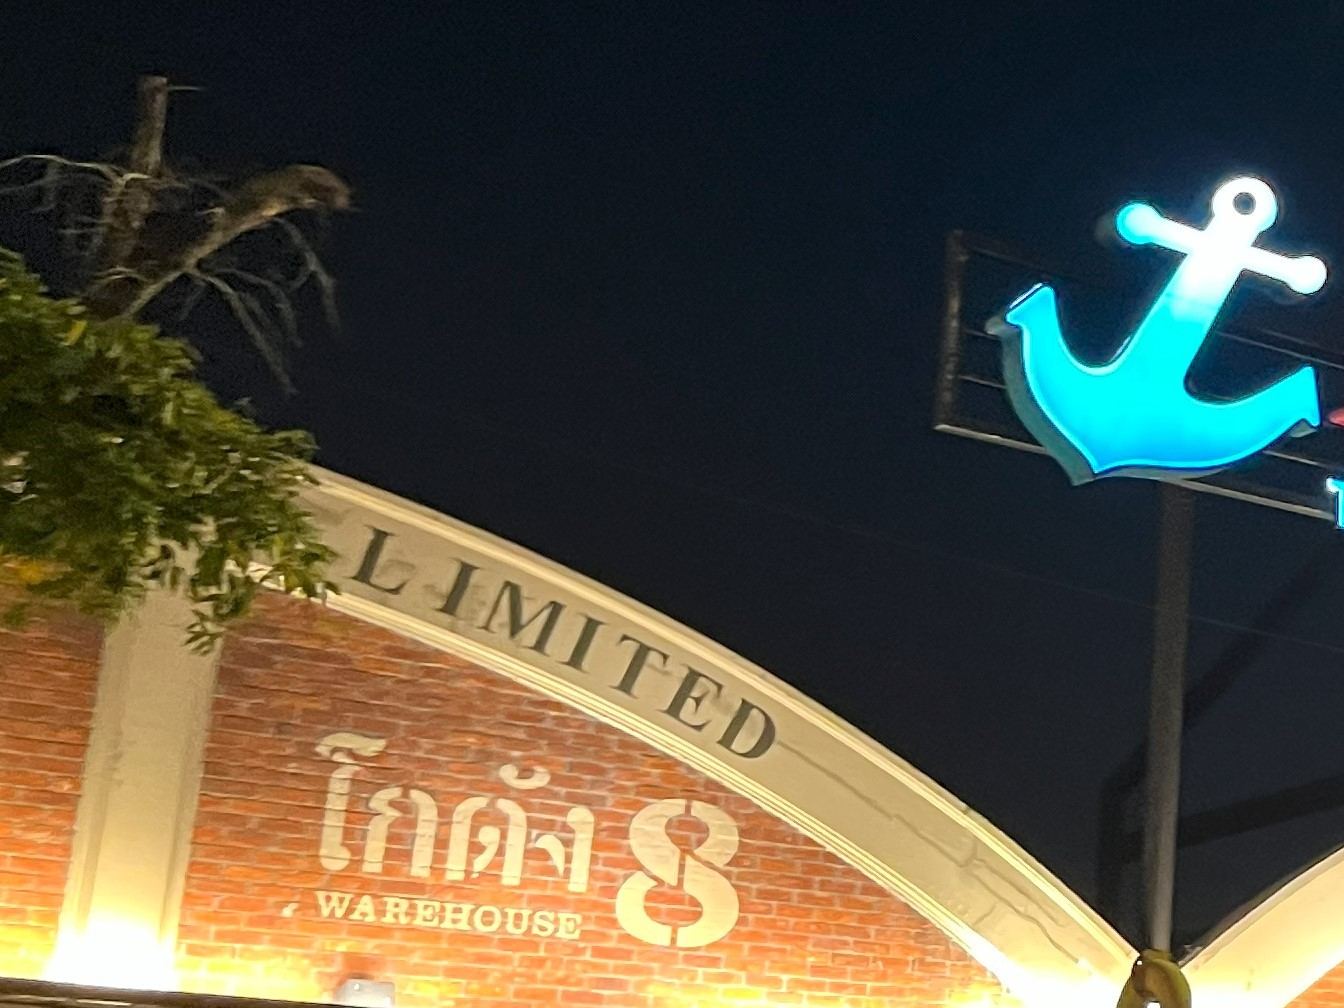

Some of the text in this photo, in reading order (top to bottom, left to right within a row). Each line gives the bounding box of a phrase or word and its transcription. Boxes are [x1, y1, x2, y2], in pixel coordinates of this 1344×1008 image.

[348, 525, 778, 760] LIMITED
[315, 733, 592, 894] โกดัง
[616, 799, 739, 947] 8
[317, 893, 582, 940] WAREHOUSE
